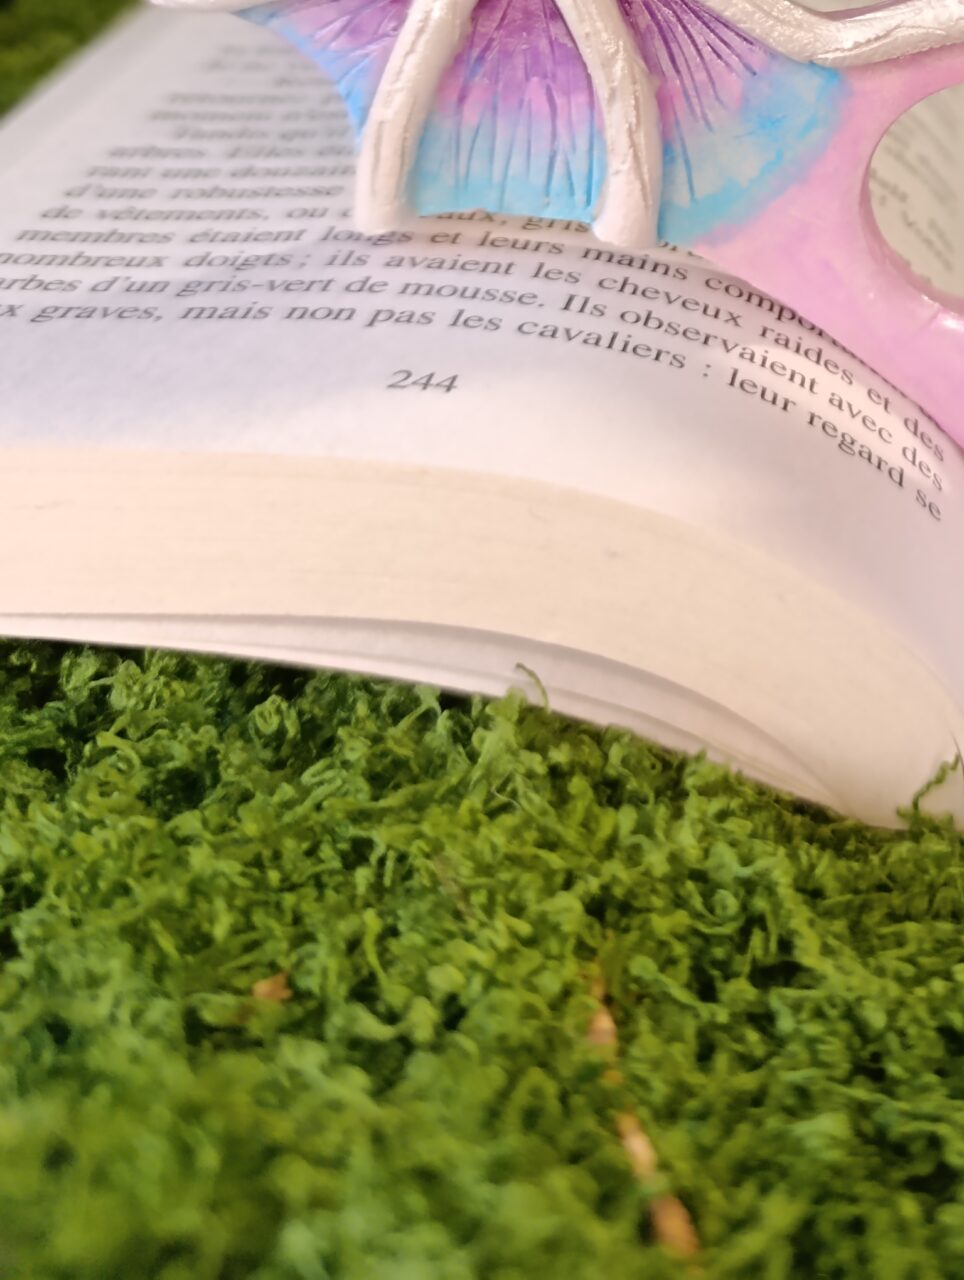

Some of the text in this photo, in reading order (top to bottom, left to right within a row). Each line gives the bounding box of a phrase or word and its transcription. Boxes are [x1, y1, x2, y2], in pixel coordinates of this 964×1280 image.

[16, 227, 175, 244] membres
[188, 227, 307, 243] étaient
[430, 230, 464, 246] et
[477, 231, 566, 255] leurs
[581, 246, 689, 282] mains
[40, 205, 83, 219] de
[286, 207, 329, 219] ou
[30, 303, 164, 323] graves,
[178, 301, 273, 320] mais
[285, 304, 357, 321] non
[365, 308, 436, 328] pas
[448, 308, 503, 332] les
[516, 320, 687, 370] cavaliers
[727, 367, 797, 413] leur
[807, 410, 905, 489] regard
[916, 488, 943, 522] se
[90, 275, 170, 294] d'un
[175, 275, 335, 298] gris-vert
[345, 275, 389, 294] de
[397, 280, 545, 309] mousse.
[560, 293, 608, 318] Ils
[618, 310, 820, 395] observaient
[827, 391, 894, 445] avec
[902, 444, 943, 492] des
[325, 250, 371, 267] ils
[385, 253, 517, 276] avaient
[531, 262, 582, 285] les
[598, 276, 744, 329] cheveux
[760, 324, 856, 386] raides
[867, 387, 893, 415] et
[903, 416, 945, 463] des
[387, 368, 459, 393] 244
